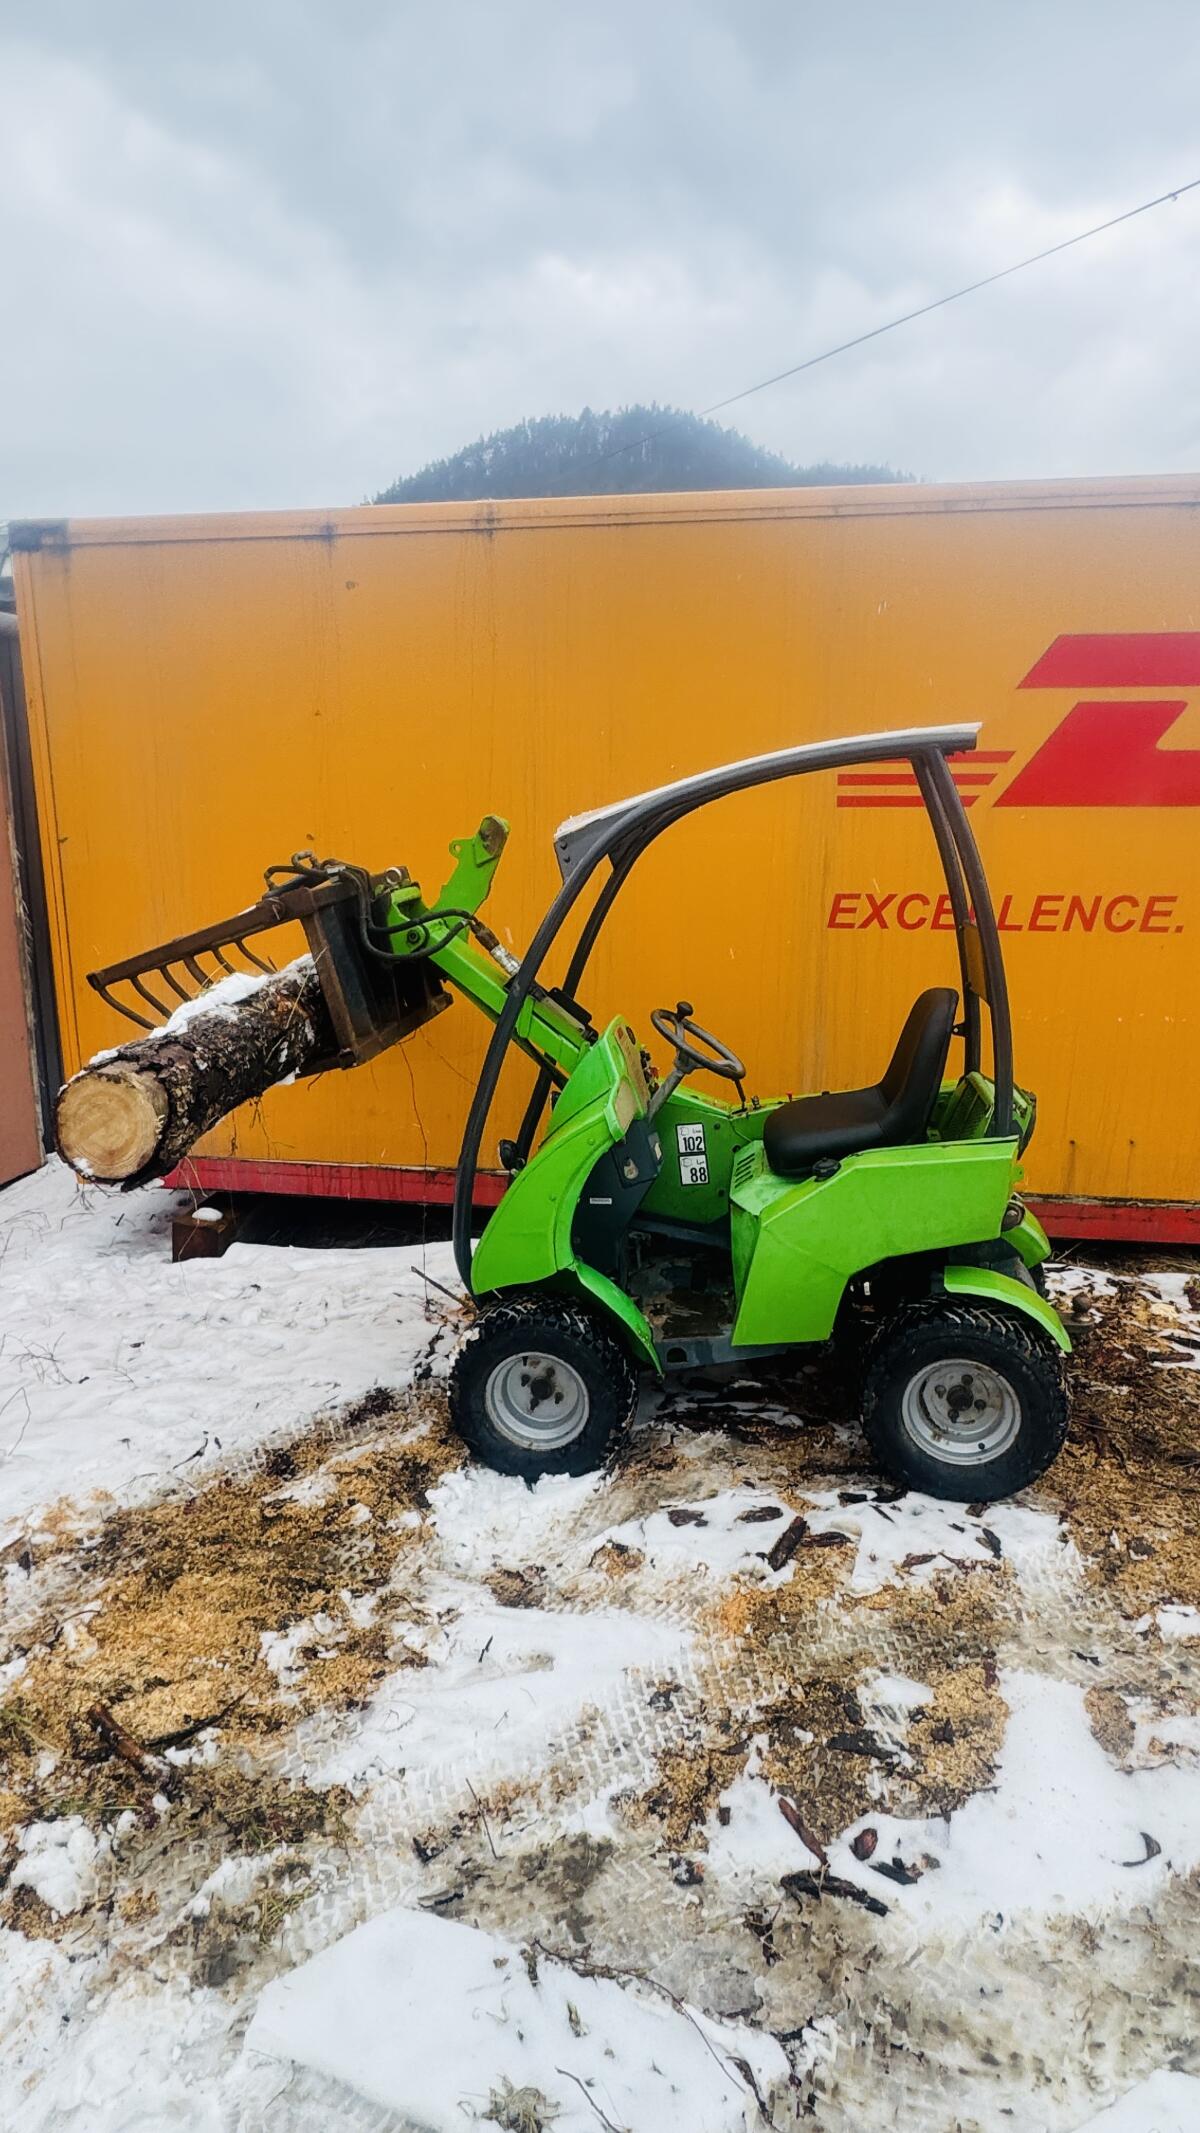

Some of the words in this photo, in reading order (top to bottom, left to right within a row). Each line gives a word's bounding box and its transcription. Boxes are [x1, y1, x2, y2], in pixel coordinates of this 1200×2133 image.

[827, 893, 1185, 933] EXCELENCE.
[683, 1136, 703, 1151] 102
[690, 1167, 707, 1183] 88
